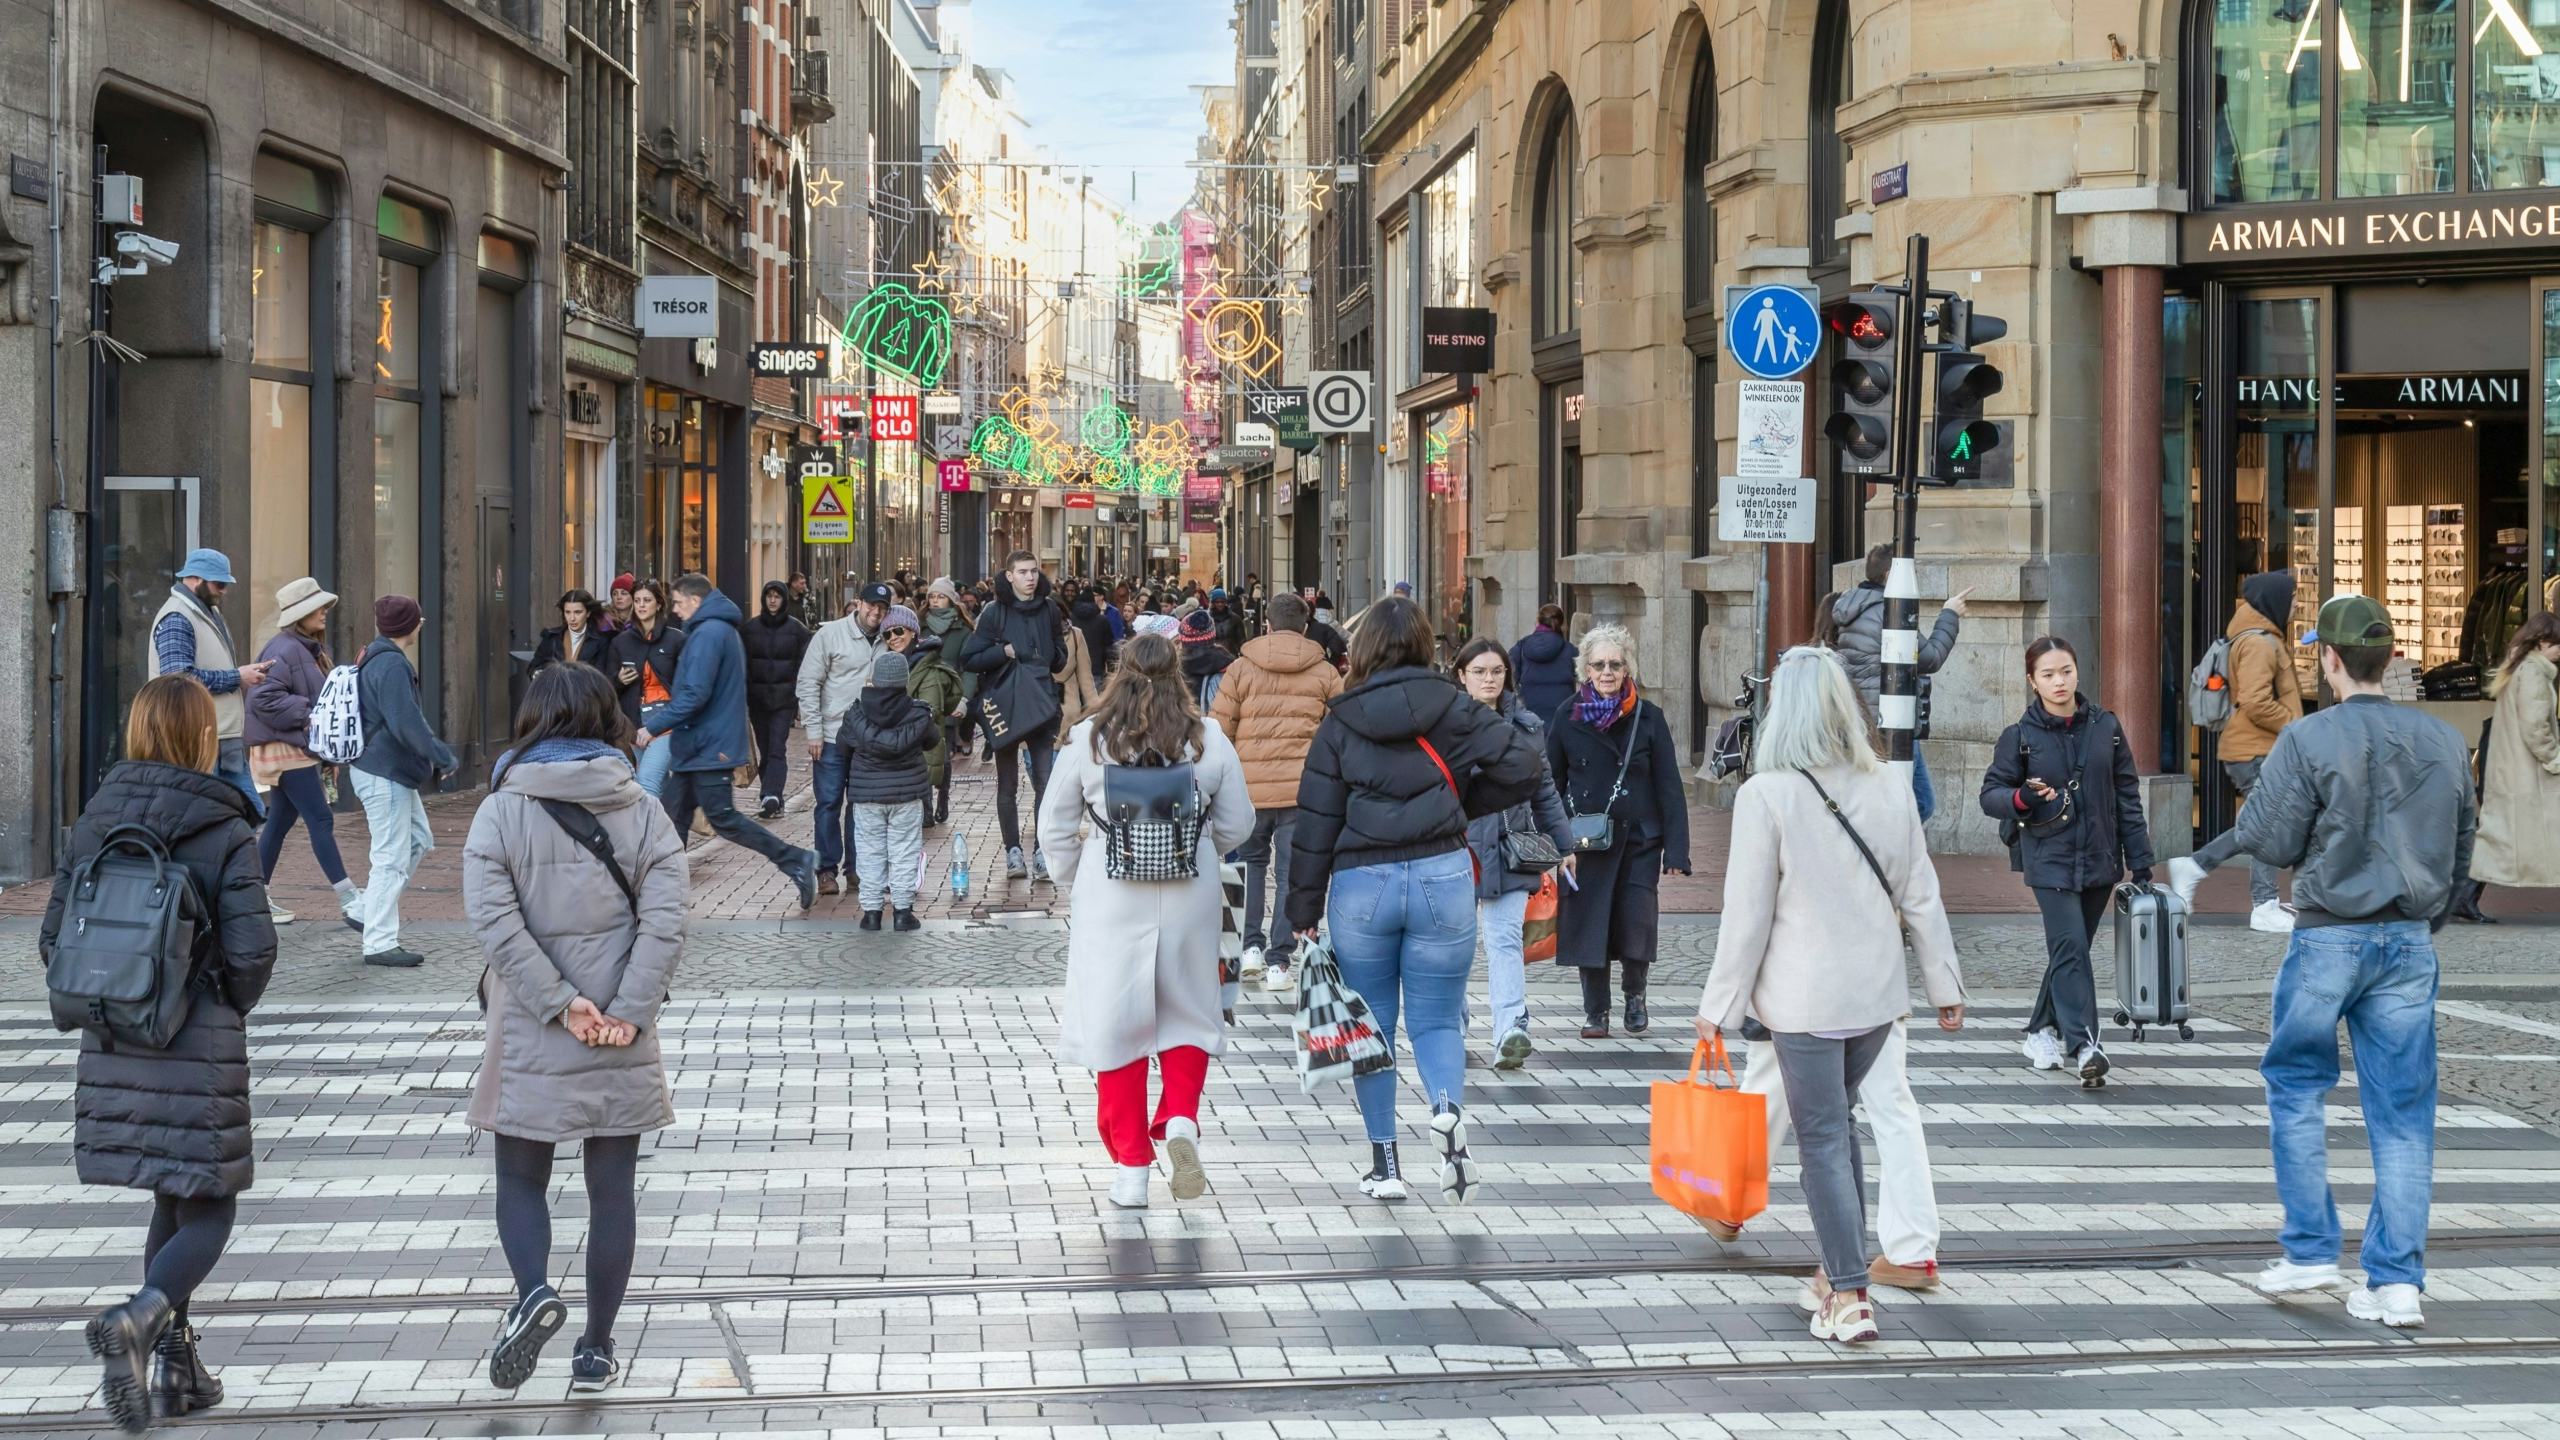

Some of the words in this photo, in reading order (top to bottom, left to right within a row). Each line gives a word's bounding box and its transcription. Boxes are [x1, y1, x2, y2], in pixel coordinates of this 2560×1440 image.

[2209, 216, 2345, 251] ARMANI
[652, 298, 709, 314] TRÉSOR
[1427, 334, 1449, 345] THE
[1451, 334, 1486, 346] STING
[758, 349, 818, 374] snipes
[1743, 383, 1802, 393] ZAKKENROLLERS
[2398, 377, 2519, 403] ARMANI
[1745, 393, 1783, 402] WINKELEN
[1784, 394, 1800, 403] OOK
[876, 400, 909, 416] UNI
[876, 419, 913, 438] QLO
[1221, 448, 1262, 457] swatch
[1737, 483, 1797, 497] Uitgezonderd
[1736, 498, 1797, 509] Laden/Lossen
[940, 493, 949, 533] MANFIELD
[1744, 508, 1757, 519] Ma
[1760, 509, 1774, 519] t/m
[1777, 509, 1788, 520] Za
[1743, 530, 1766, 539] Alleen
[1767, 531, 1787, 539] Links
